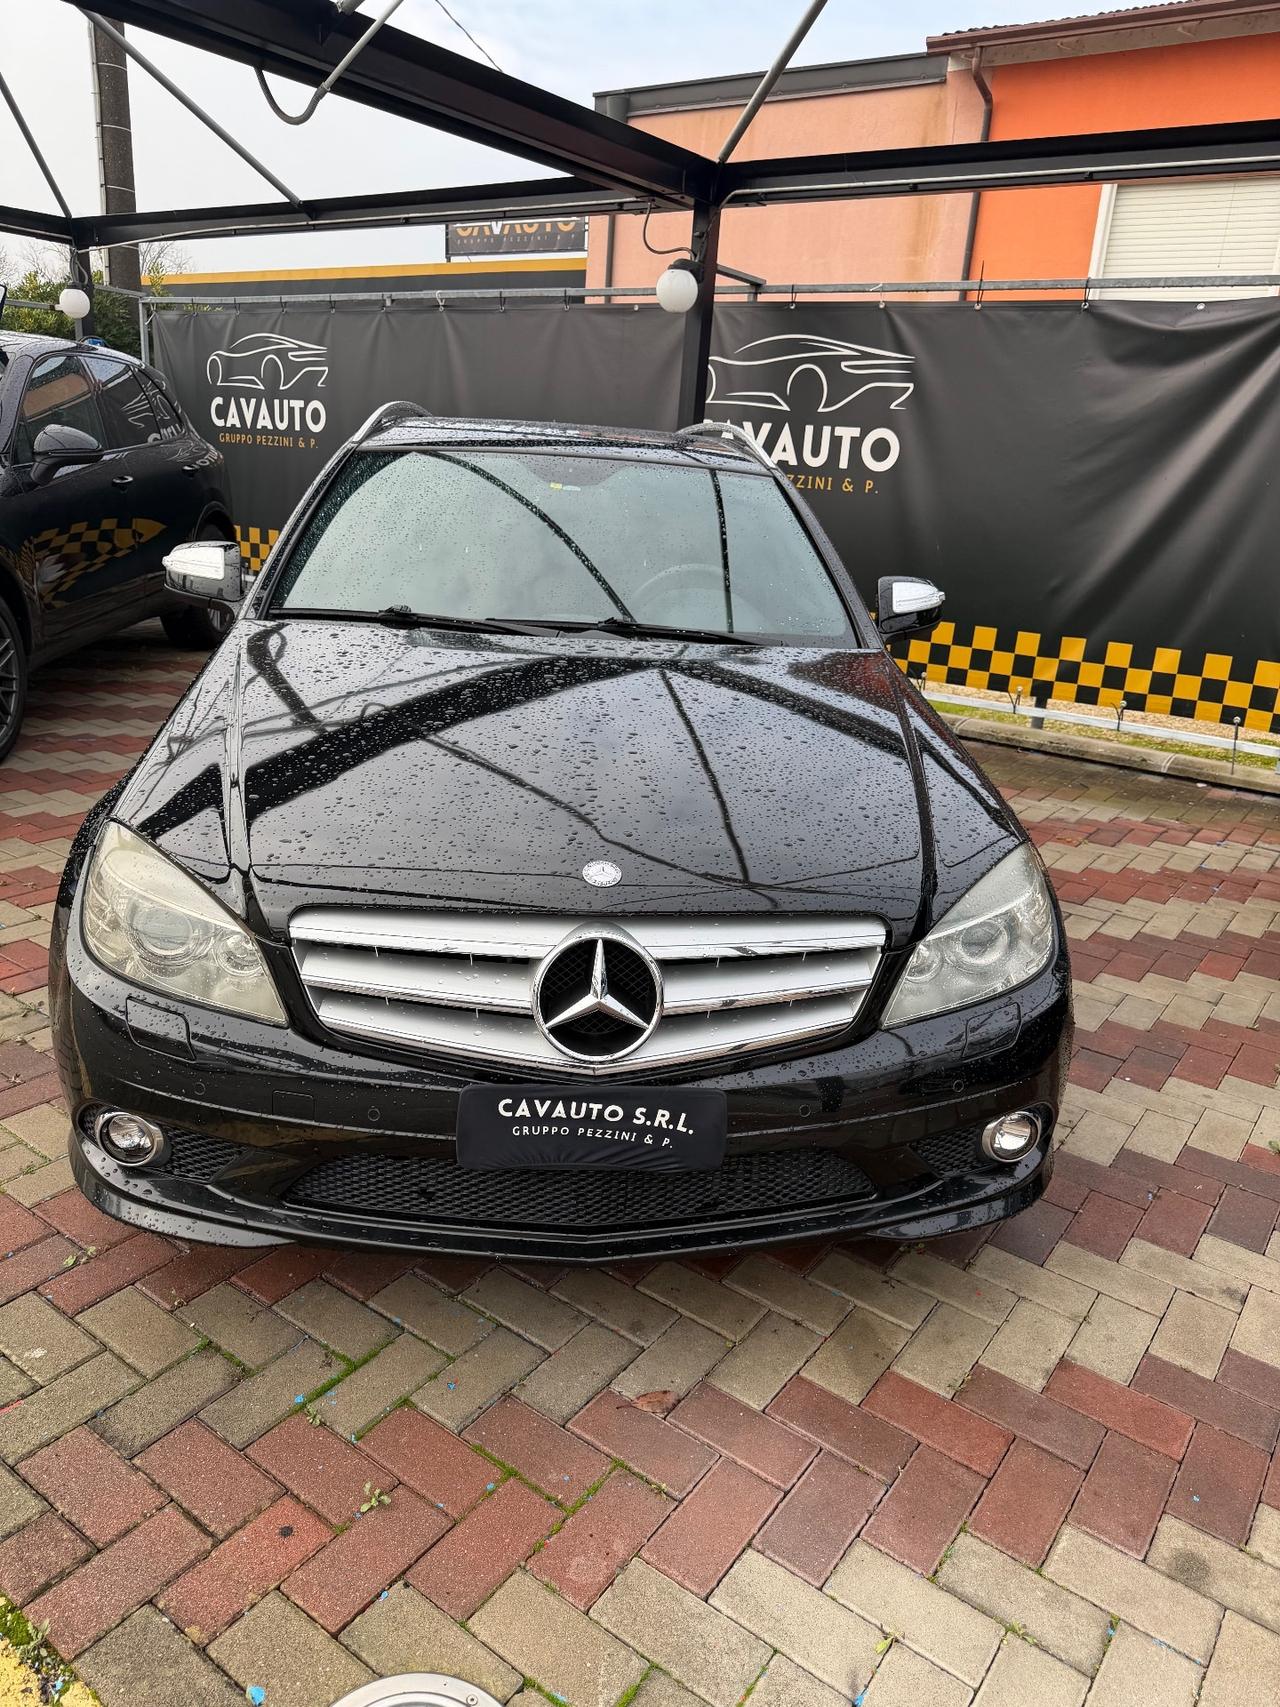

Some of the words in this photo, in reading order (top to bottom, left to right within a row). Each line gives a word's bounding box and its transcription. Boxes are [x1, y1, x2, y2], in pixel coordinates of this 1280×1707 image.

[210, 396, 327, 433] CAVAUTO
[219, 432, 253, 444] GRUPPO
[256, 435, 293, 447] PEZZINI
[298, 437, 305, 448] &
[310, 438, 319, 449] P.
[703, 418, 901, 472] VAUTO
[842, 478, 854, 492] &
[864, 479, 879, 494] P.
[498, 1098, 624, 1122] CAVAUTO
[632, 1107, 694, 1135] S.R.L.
[512, 1126, 570, 1136] GRUPPO
[577, 1127, 637, 1142] PEZZINI
[644, 1134, 653, 1146] &
[661, 1137, 673, 1149] P.
